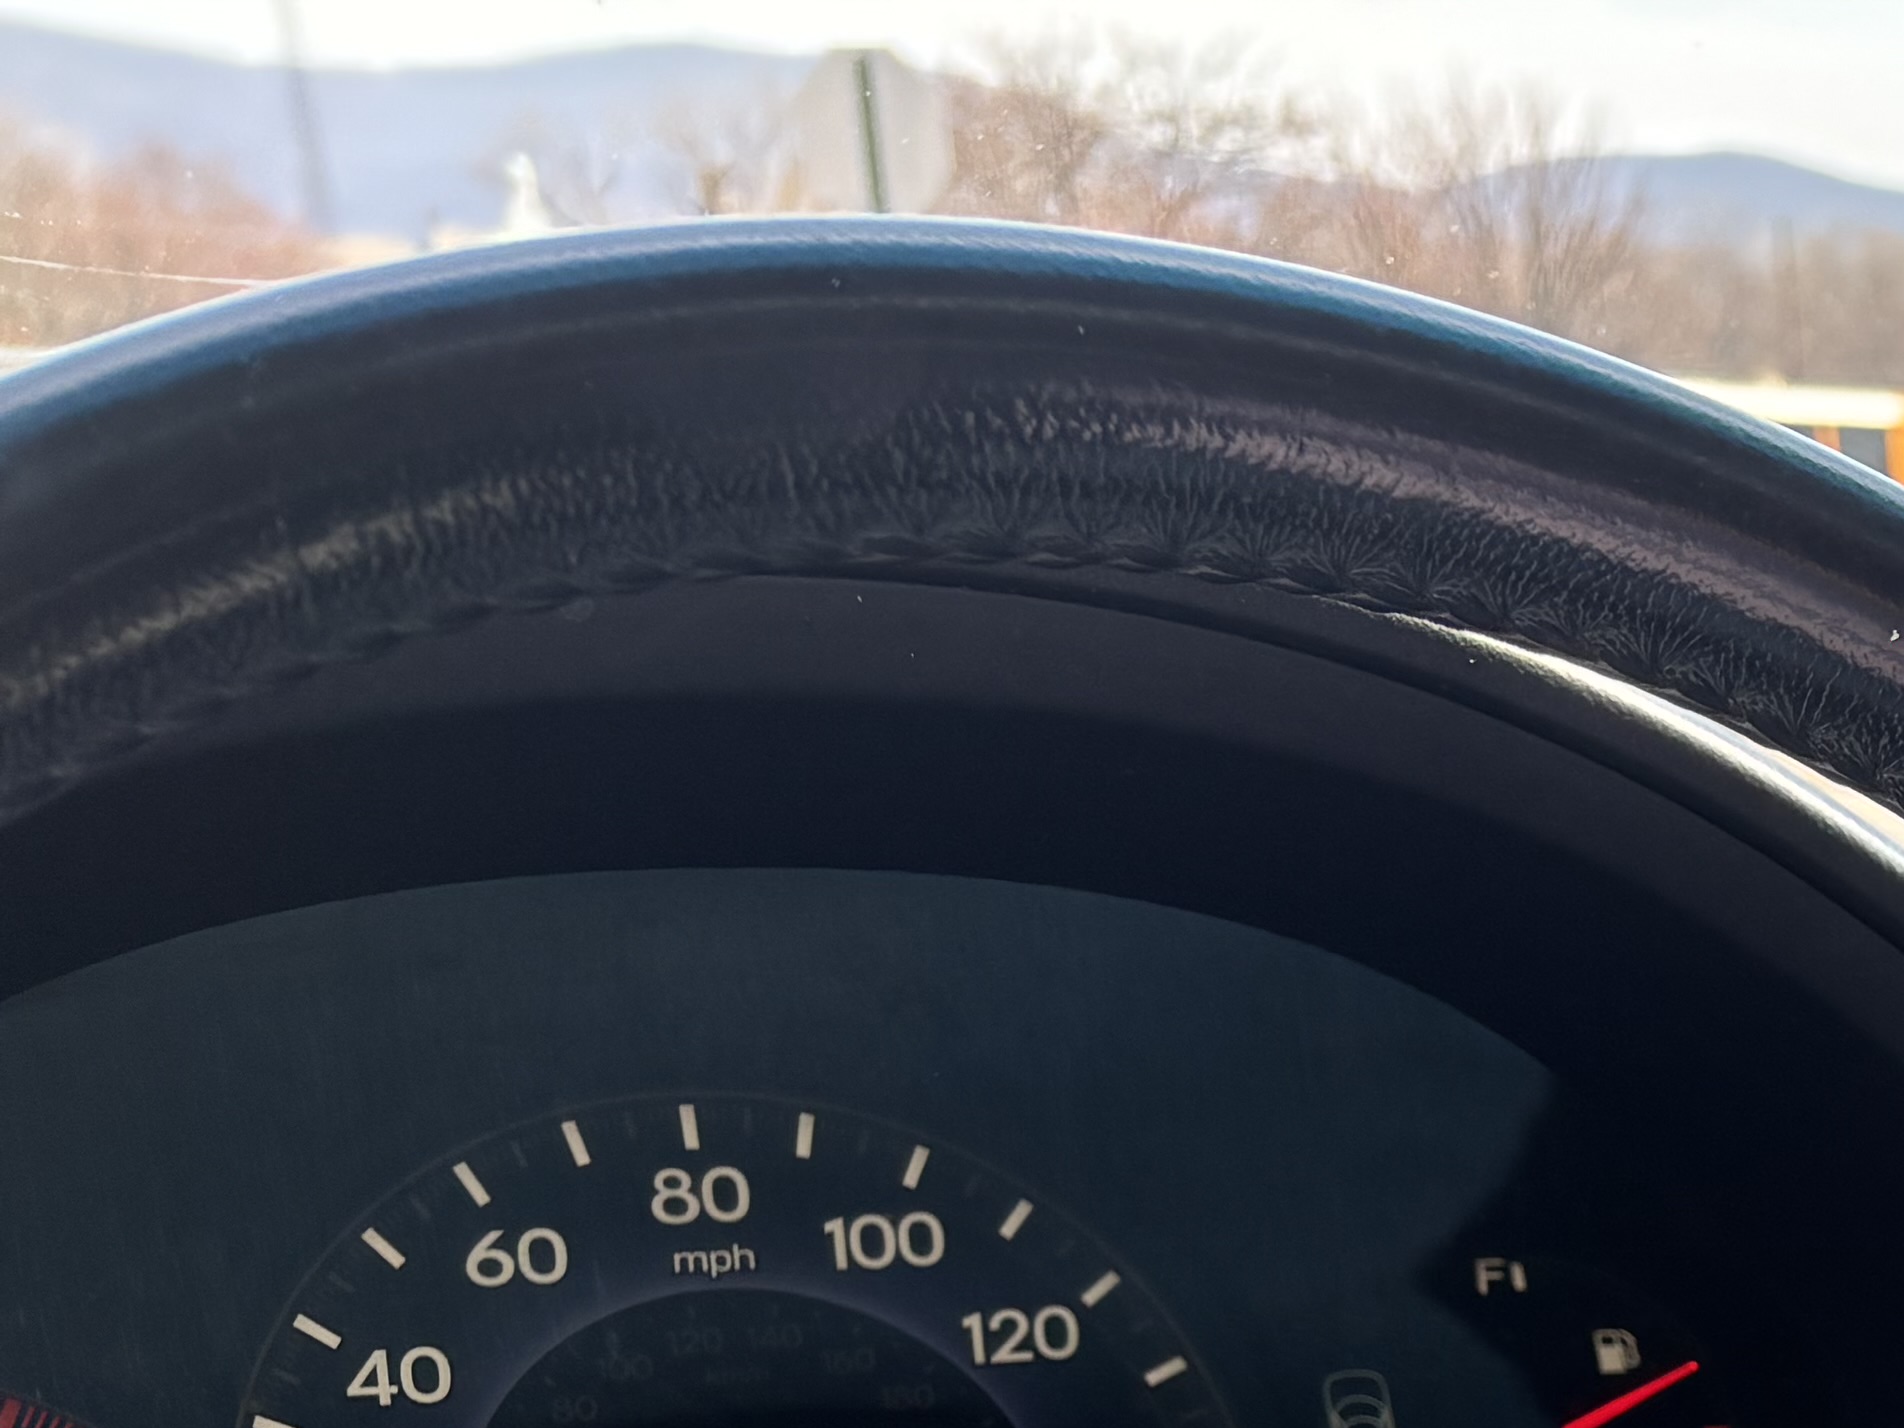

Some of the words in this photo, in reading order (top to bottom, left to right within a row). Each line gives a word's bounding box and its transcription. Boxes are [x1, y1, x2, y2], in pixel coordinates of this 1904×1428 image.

[650, 1165, 752, 1225] 80
[465, 1226, 569, 1288] 60
[672, 1242, 757, 1275] mph
[822, 1211, 947, 1271] 100
[1474, 1257, 1507, 1296] F
[961, 1304, 1081, 1367] 120
[345, 1344, 454, 1407] 40
